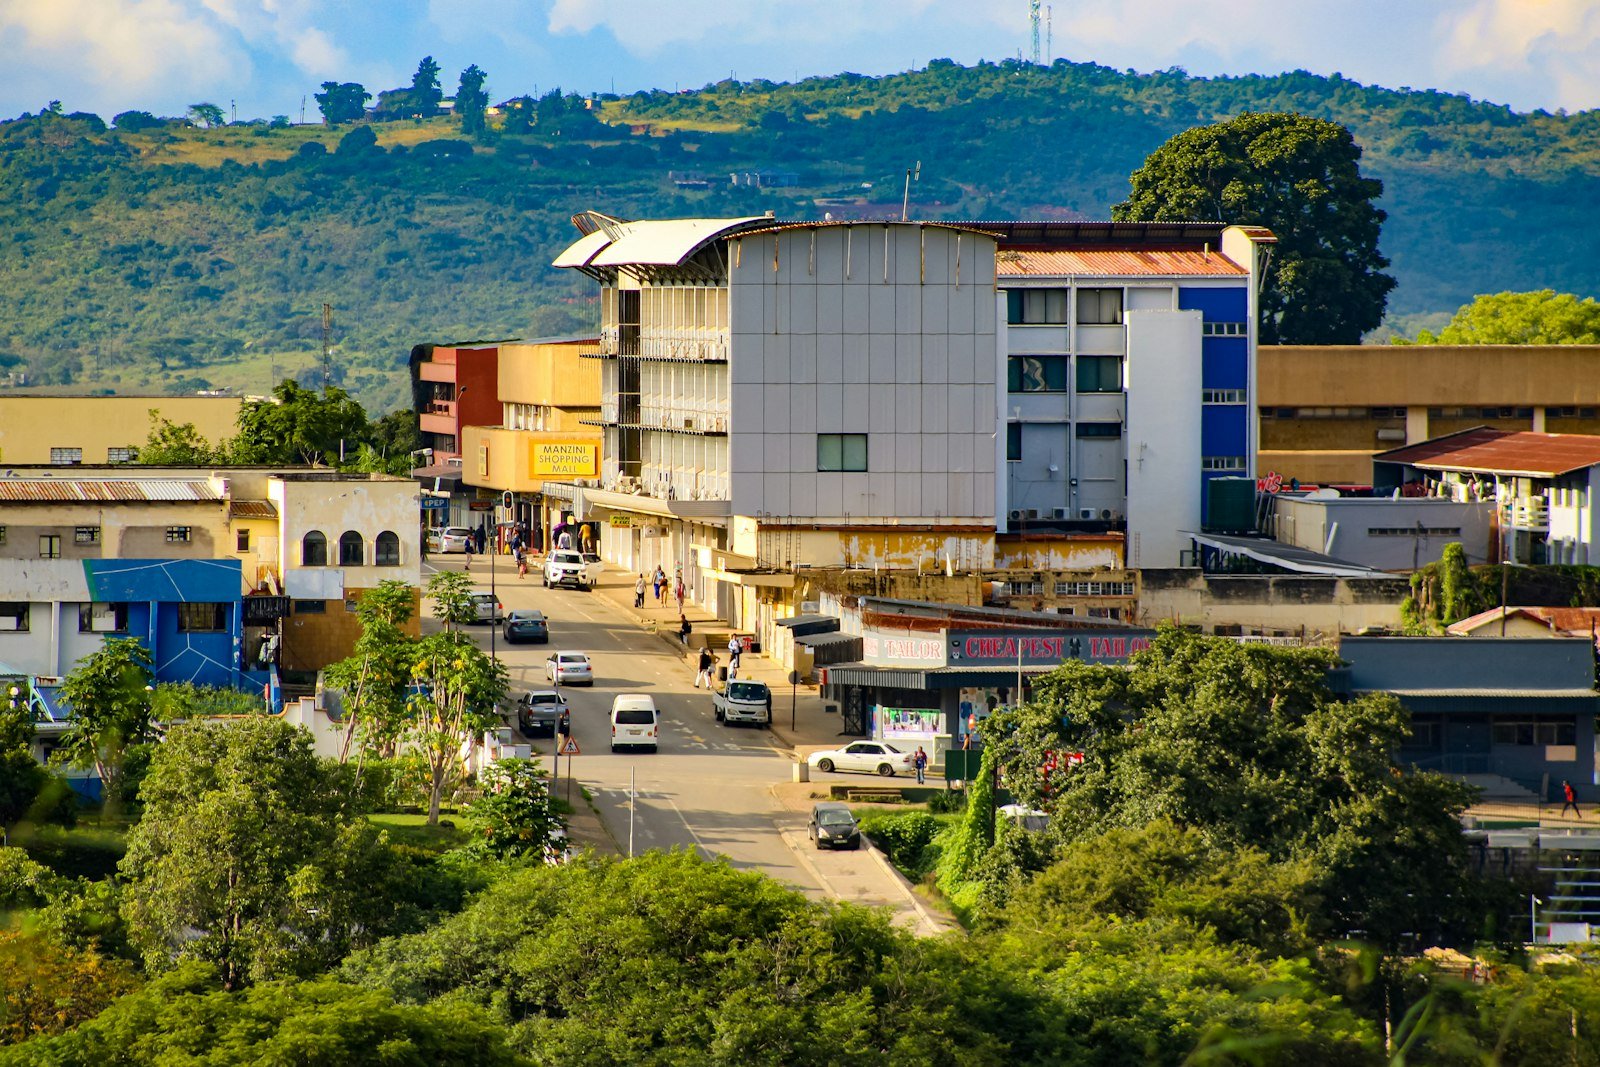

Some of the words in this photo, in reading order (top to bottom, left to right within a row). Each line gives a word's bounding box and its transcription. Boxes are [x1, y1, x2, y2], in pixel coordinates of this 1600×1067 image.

[543, 445, 586, 454] MANZINI
[539, 455, 590, 463] SHOPPING
[428, 499, 445, 507] PEP
[884, 639, 943, 659] TAILOR
[965, 637, 1065, 659] CHEAPEST
